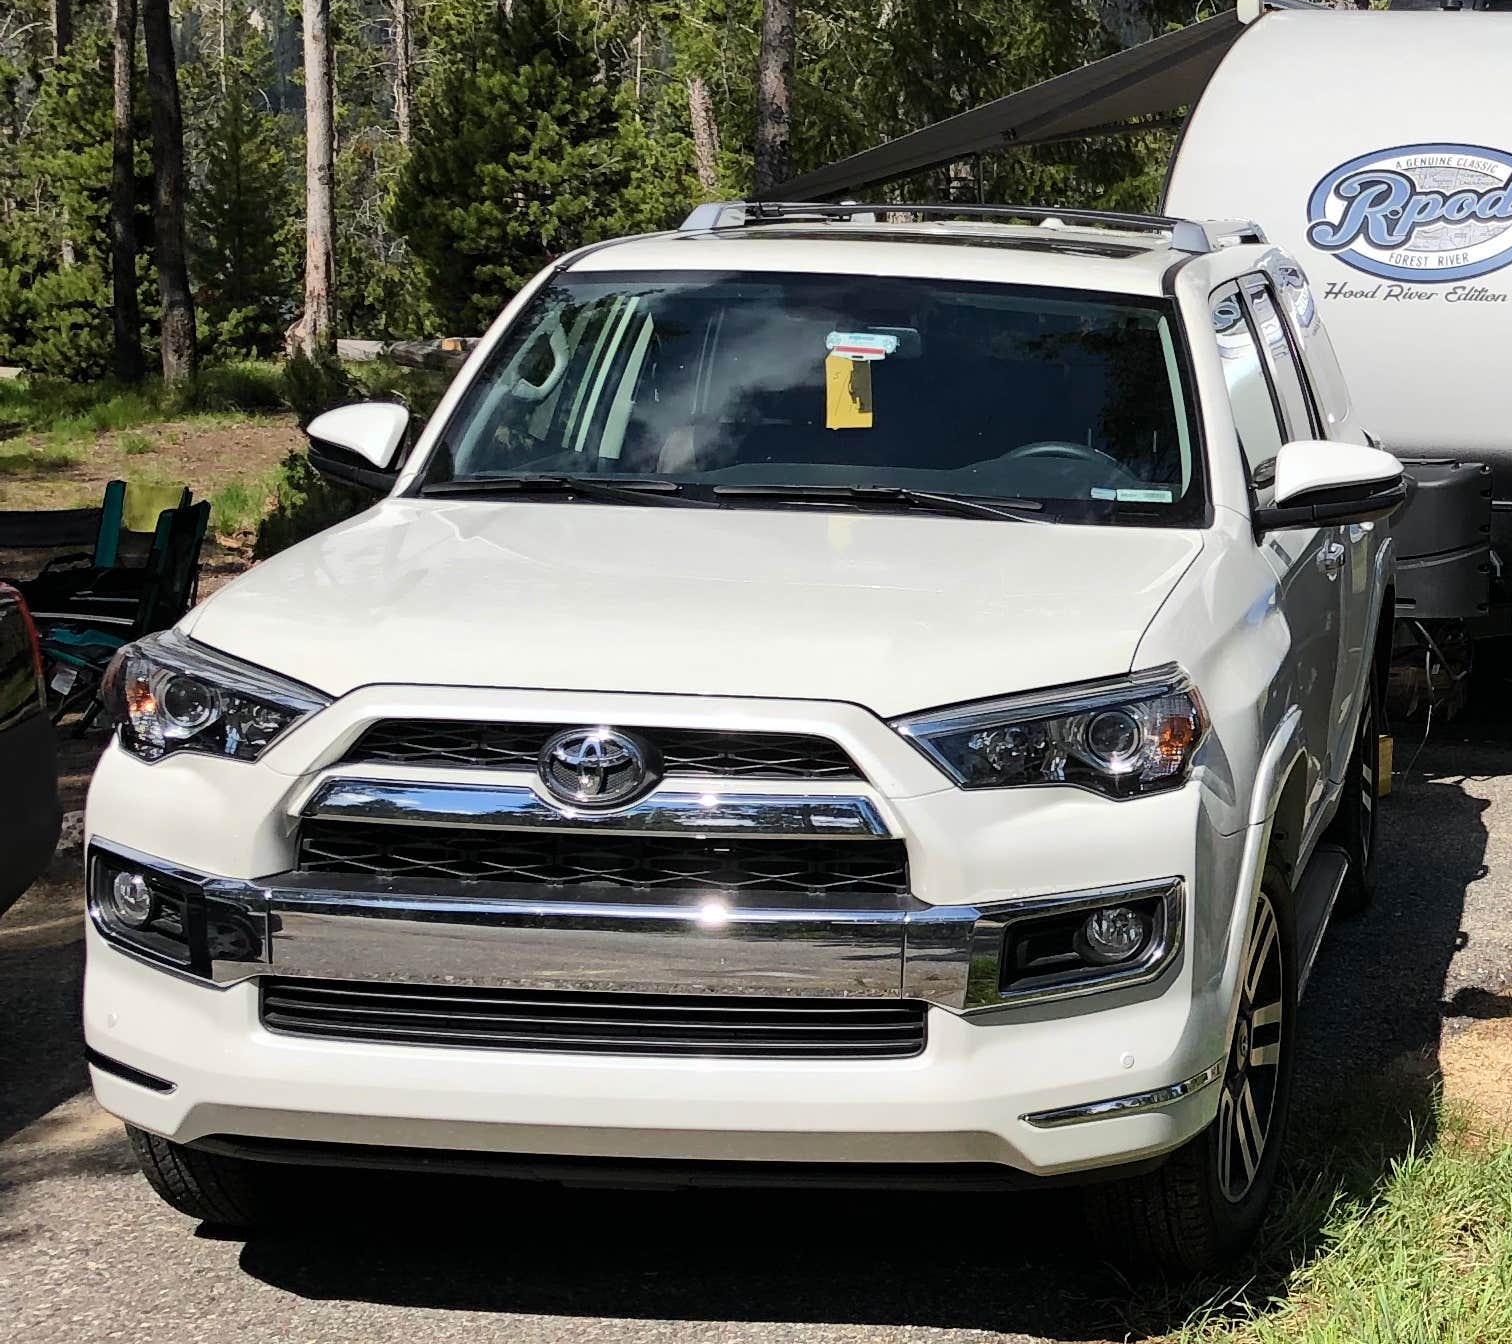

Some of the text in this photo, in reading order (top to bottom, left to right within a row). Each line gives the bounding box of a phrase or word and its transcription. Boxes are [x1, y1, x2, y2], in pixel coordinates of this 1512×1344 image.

[1395, 157, 1499, 174] A GENUINE CLASSIC
[1389, 252, 1469, 267] FOREST RIVER
[1323, 281, 1509, 303] Hood River Edition
